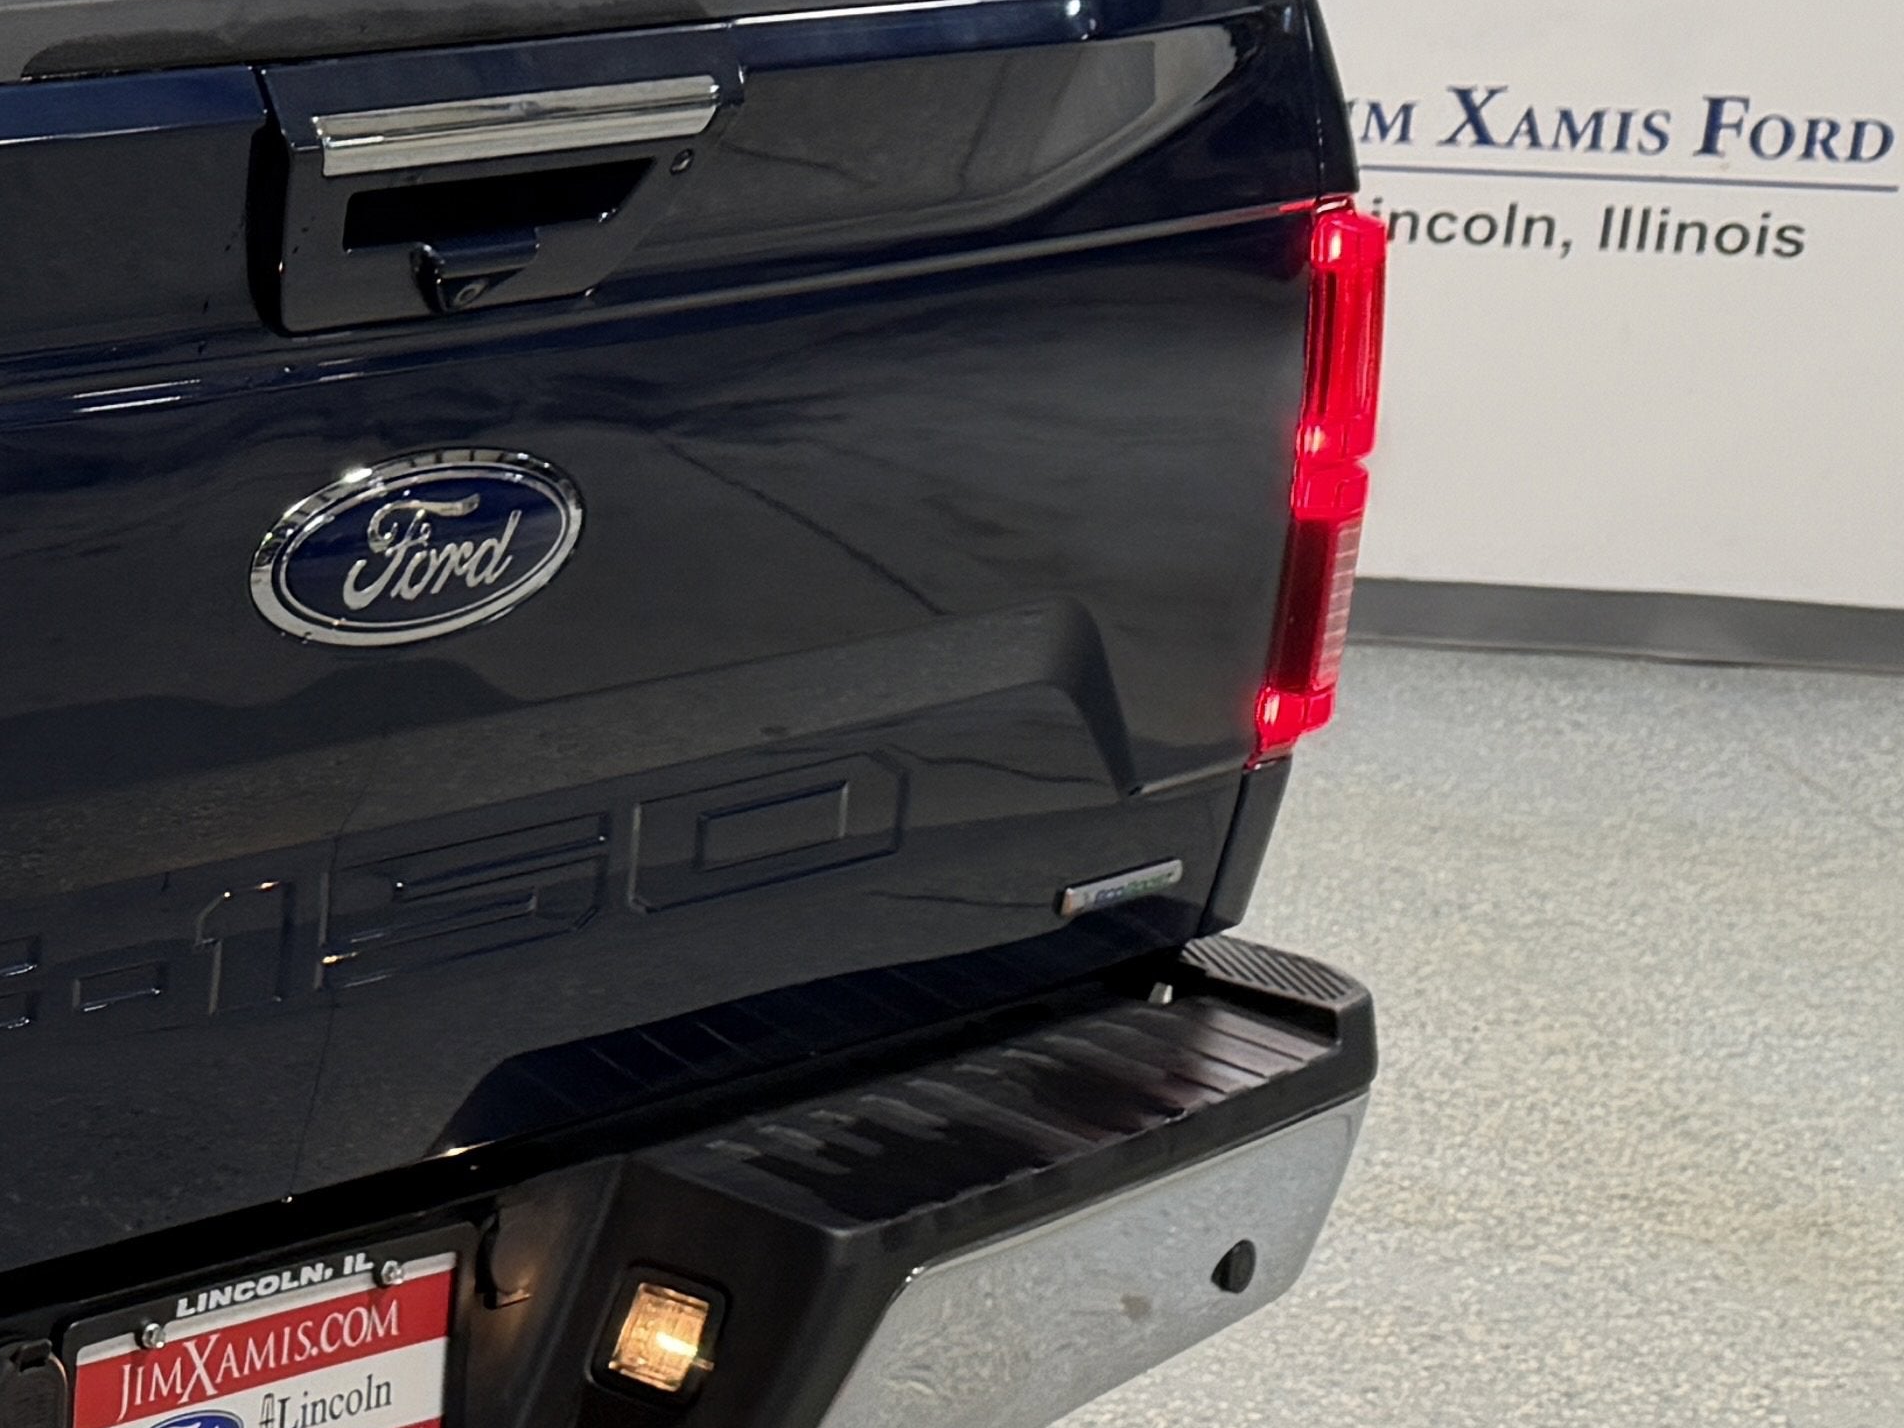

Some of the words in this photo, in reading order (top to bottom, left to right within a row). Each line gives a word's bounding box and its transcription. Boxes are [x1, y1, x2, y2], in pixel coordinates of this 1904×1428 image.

[1436, 84, 1671, 156] XAMIS
[1692, 94, 1894, 164] FORD
[1598, 204, 1806, 259] Illinois
[342, 492, 523, 611] Ford
[176, 1262, 333, 1319] LINCOLN,
[343, 1252, 374, 1276] IL
[117, 1299, 400, 1422] JIMXAMIS.COM
